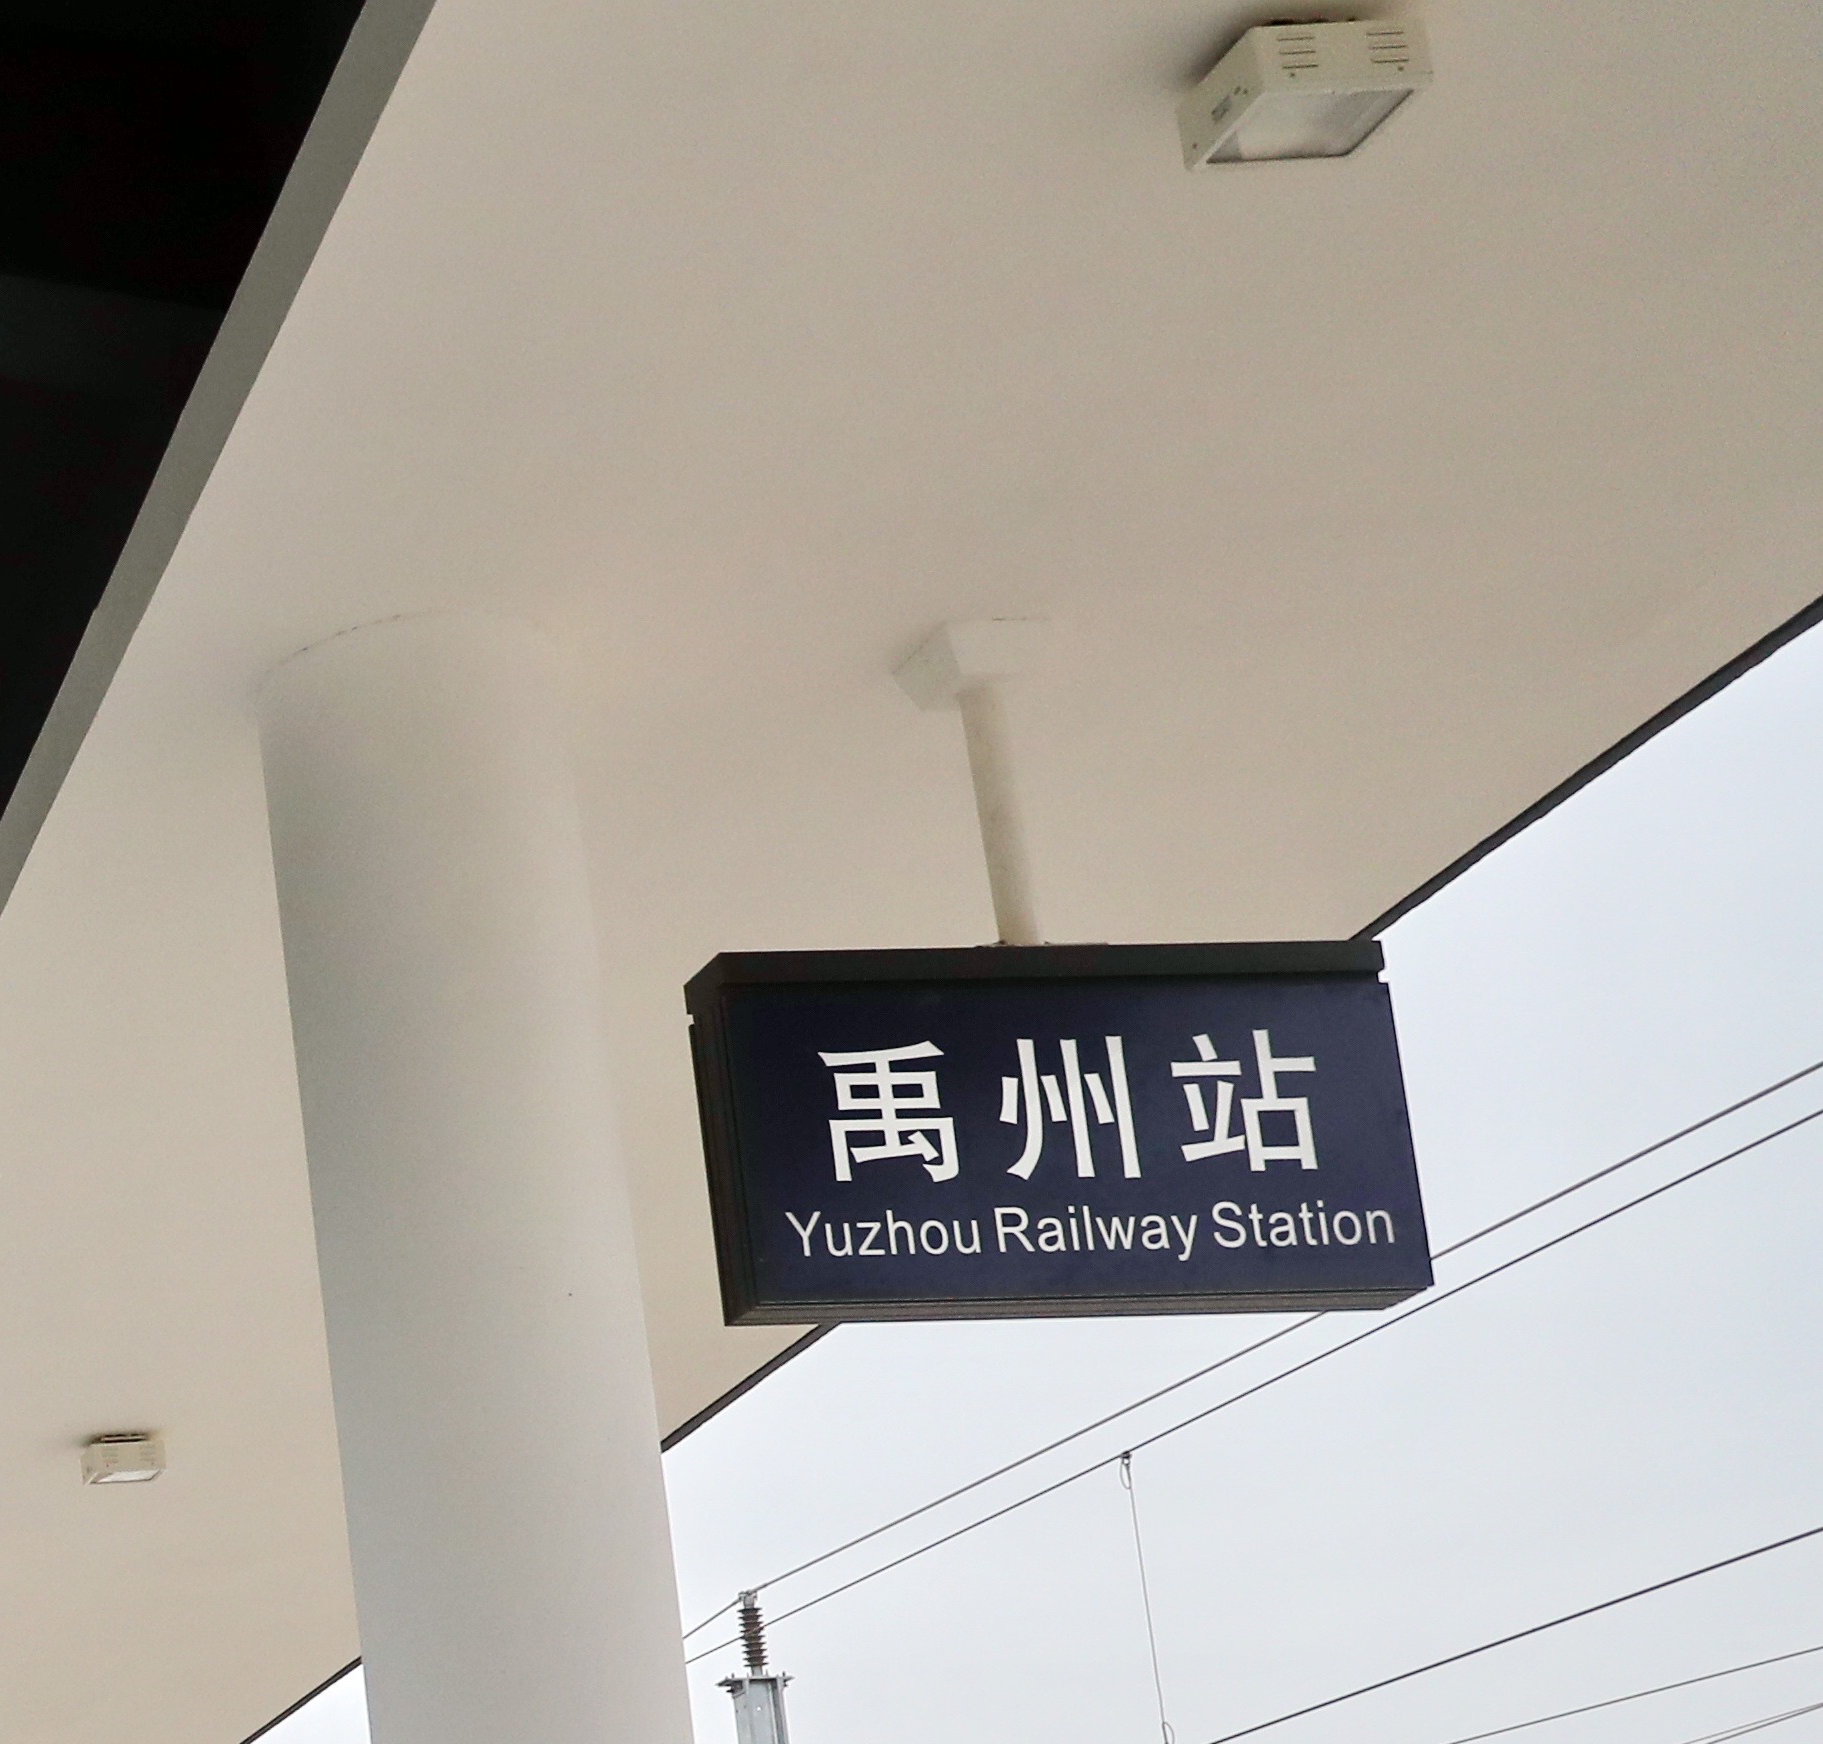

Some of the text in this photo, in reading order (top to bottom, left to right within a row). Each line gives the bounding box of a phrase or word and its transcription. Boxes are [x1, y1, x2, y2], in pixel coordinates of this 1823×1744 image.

[817, 1029, 1319, 1183] 禹州站
[784, 1199, 1396, 1262] Yuzhou Railway Station
